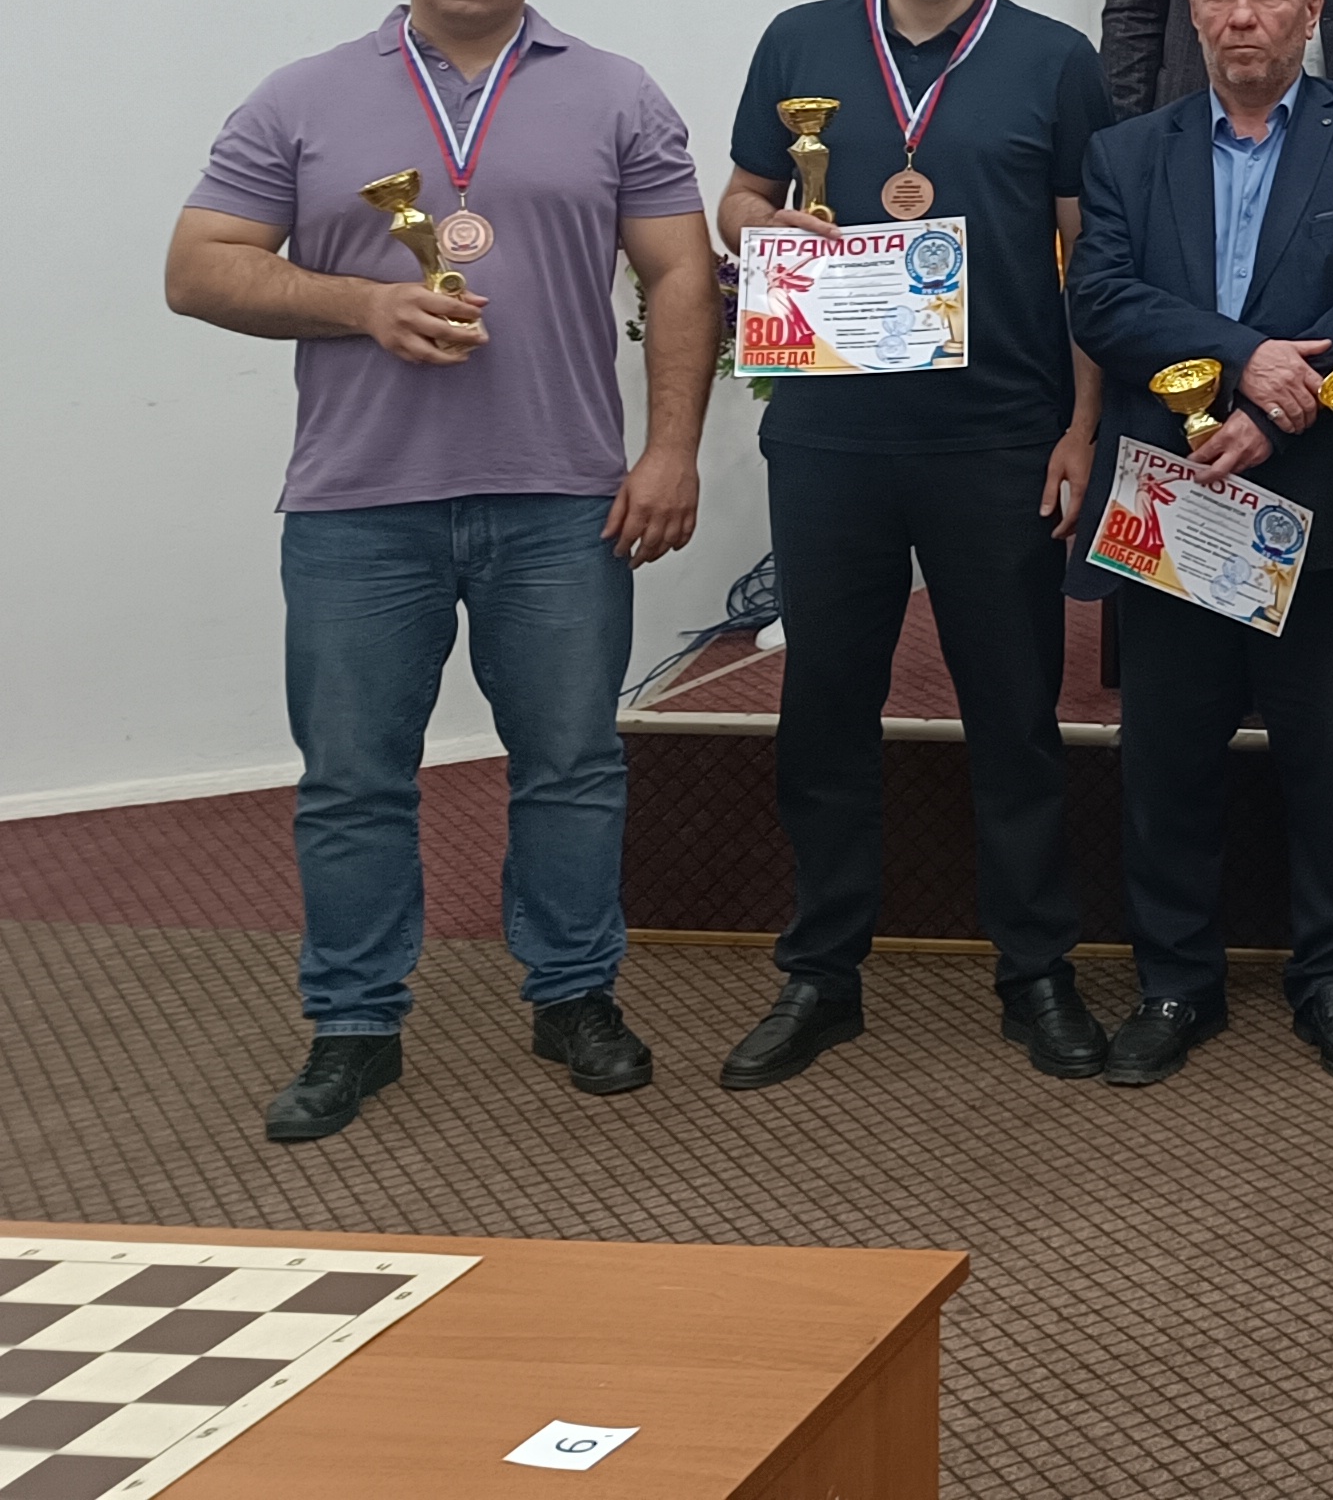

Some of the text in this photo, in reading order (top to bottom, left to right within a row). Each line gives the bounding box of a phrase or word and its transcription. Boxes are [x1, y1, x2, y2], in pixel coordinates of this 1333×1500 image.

[757, 234, 905, 257] ГРАМОТА
[745, 316, 784, 347] 80
[743, 350, 816, 368] ПОБЕДА!
[1107, 509, 1143, 546] 80
[1100, 541, 1160, 576] ПОБЕДА!
